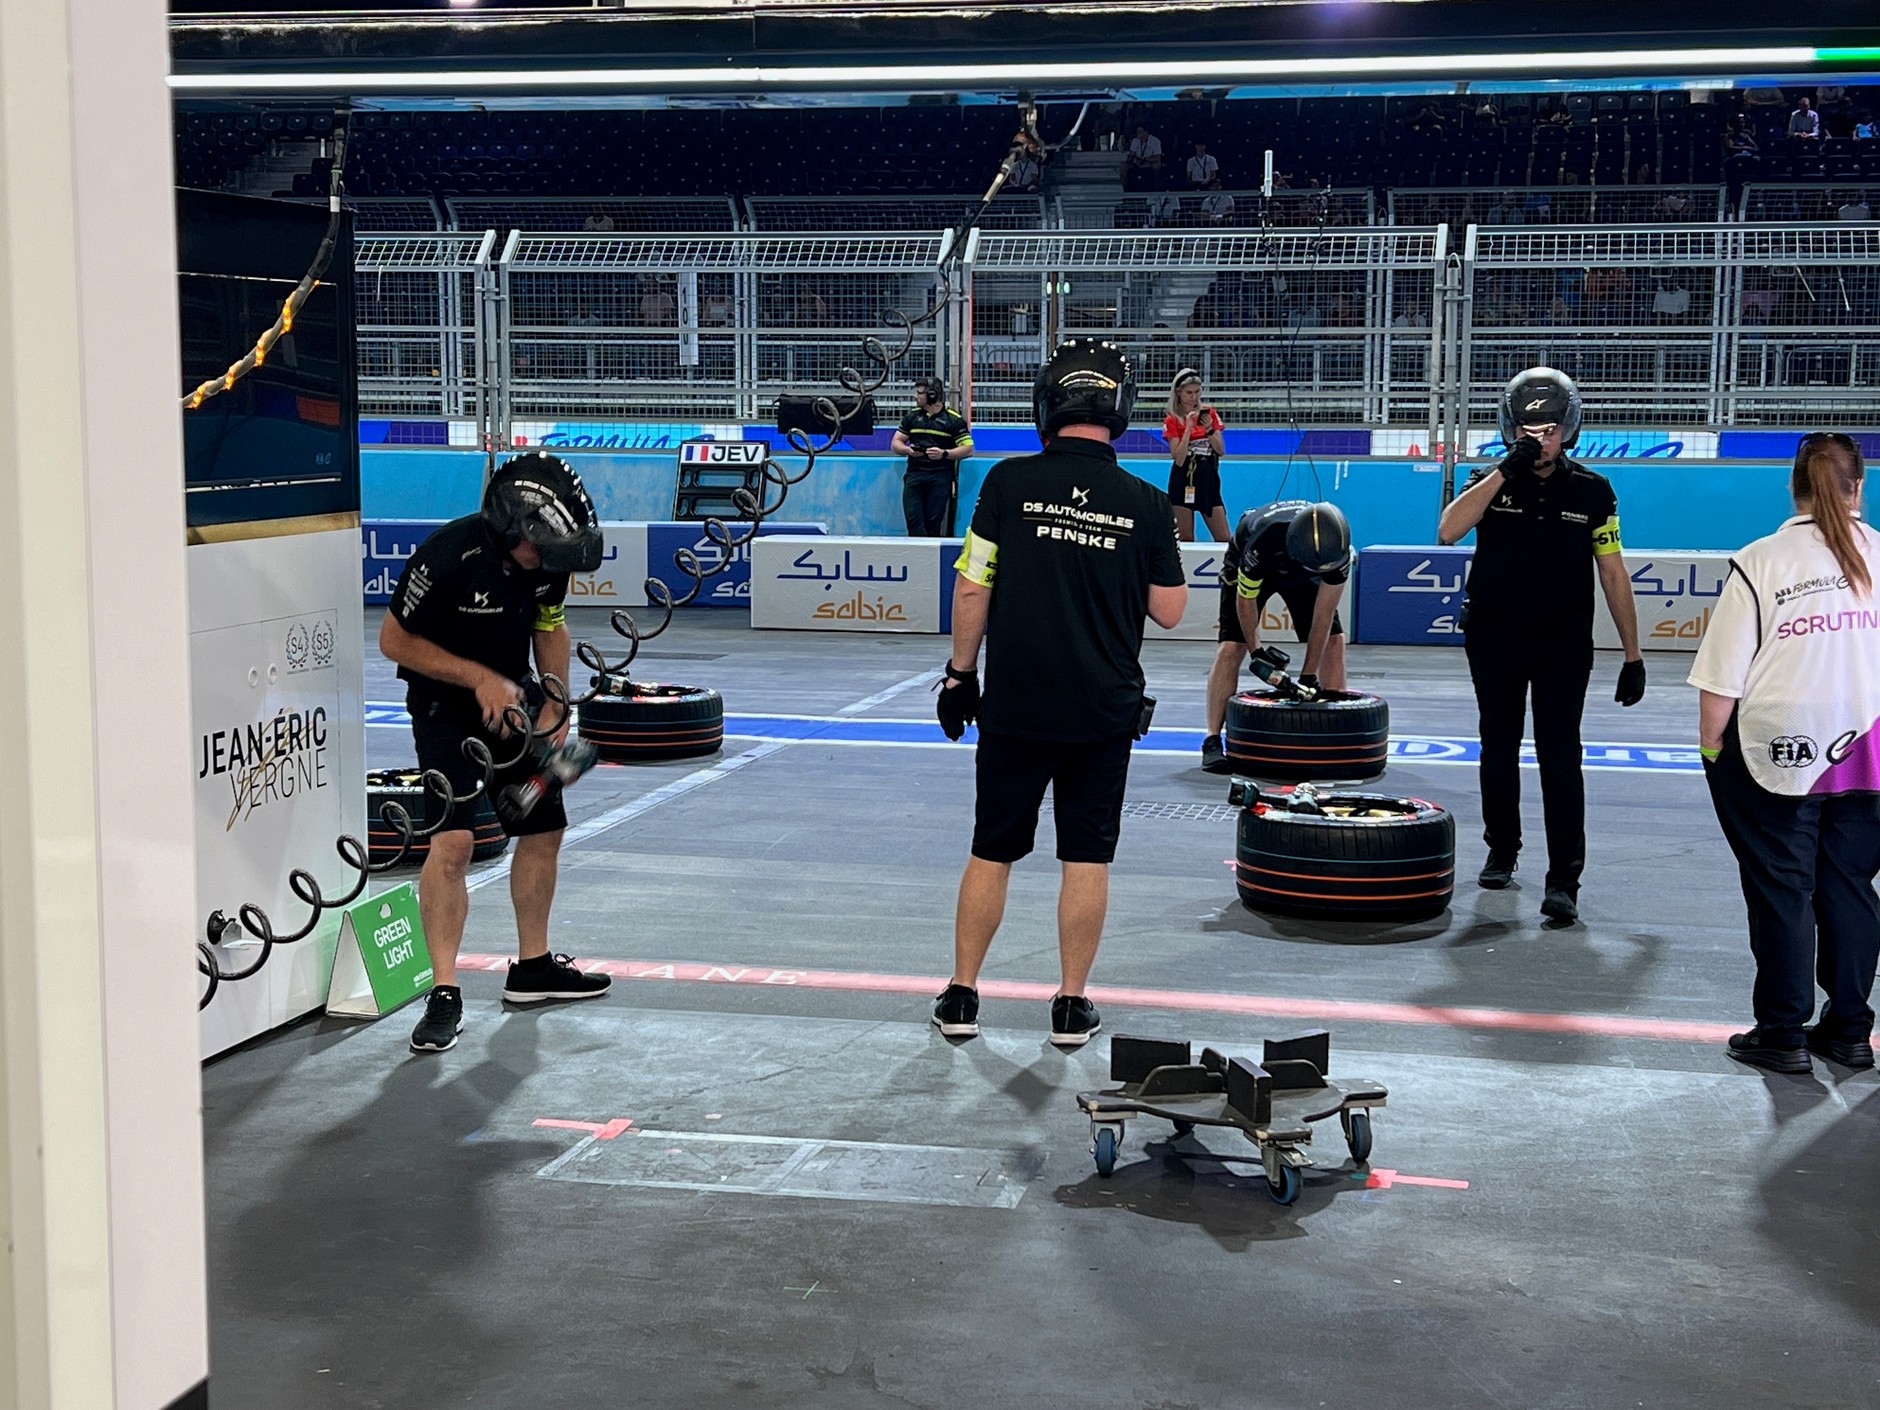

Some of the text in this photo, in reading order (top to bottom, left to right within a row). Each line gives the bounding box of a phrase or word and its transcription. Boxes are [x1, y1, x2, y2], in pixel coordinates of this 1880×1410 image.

[711, 446, 760, 463] JEV
[1022, 502, 1134, 529] DS AUTOMOBILES
[1036, 525, 1117, 550] PENSKE
[570, 571, 618, 596] bic
[812, 590, 908, 621] sabic
[1777, 610, 1880, 640] SCRUTIN
[291, 636, 304, 655] S4
[316, 632, 330, 651] S5
[199, 706, 327, 779] JEAN-ÉRIC
[230, 746, 328, 813] VERGNE
[373, 916, 412, 948] GREEN
[383, 939, 414, 970] LIGHT
